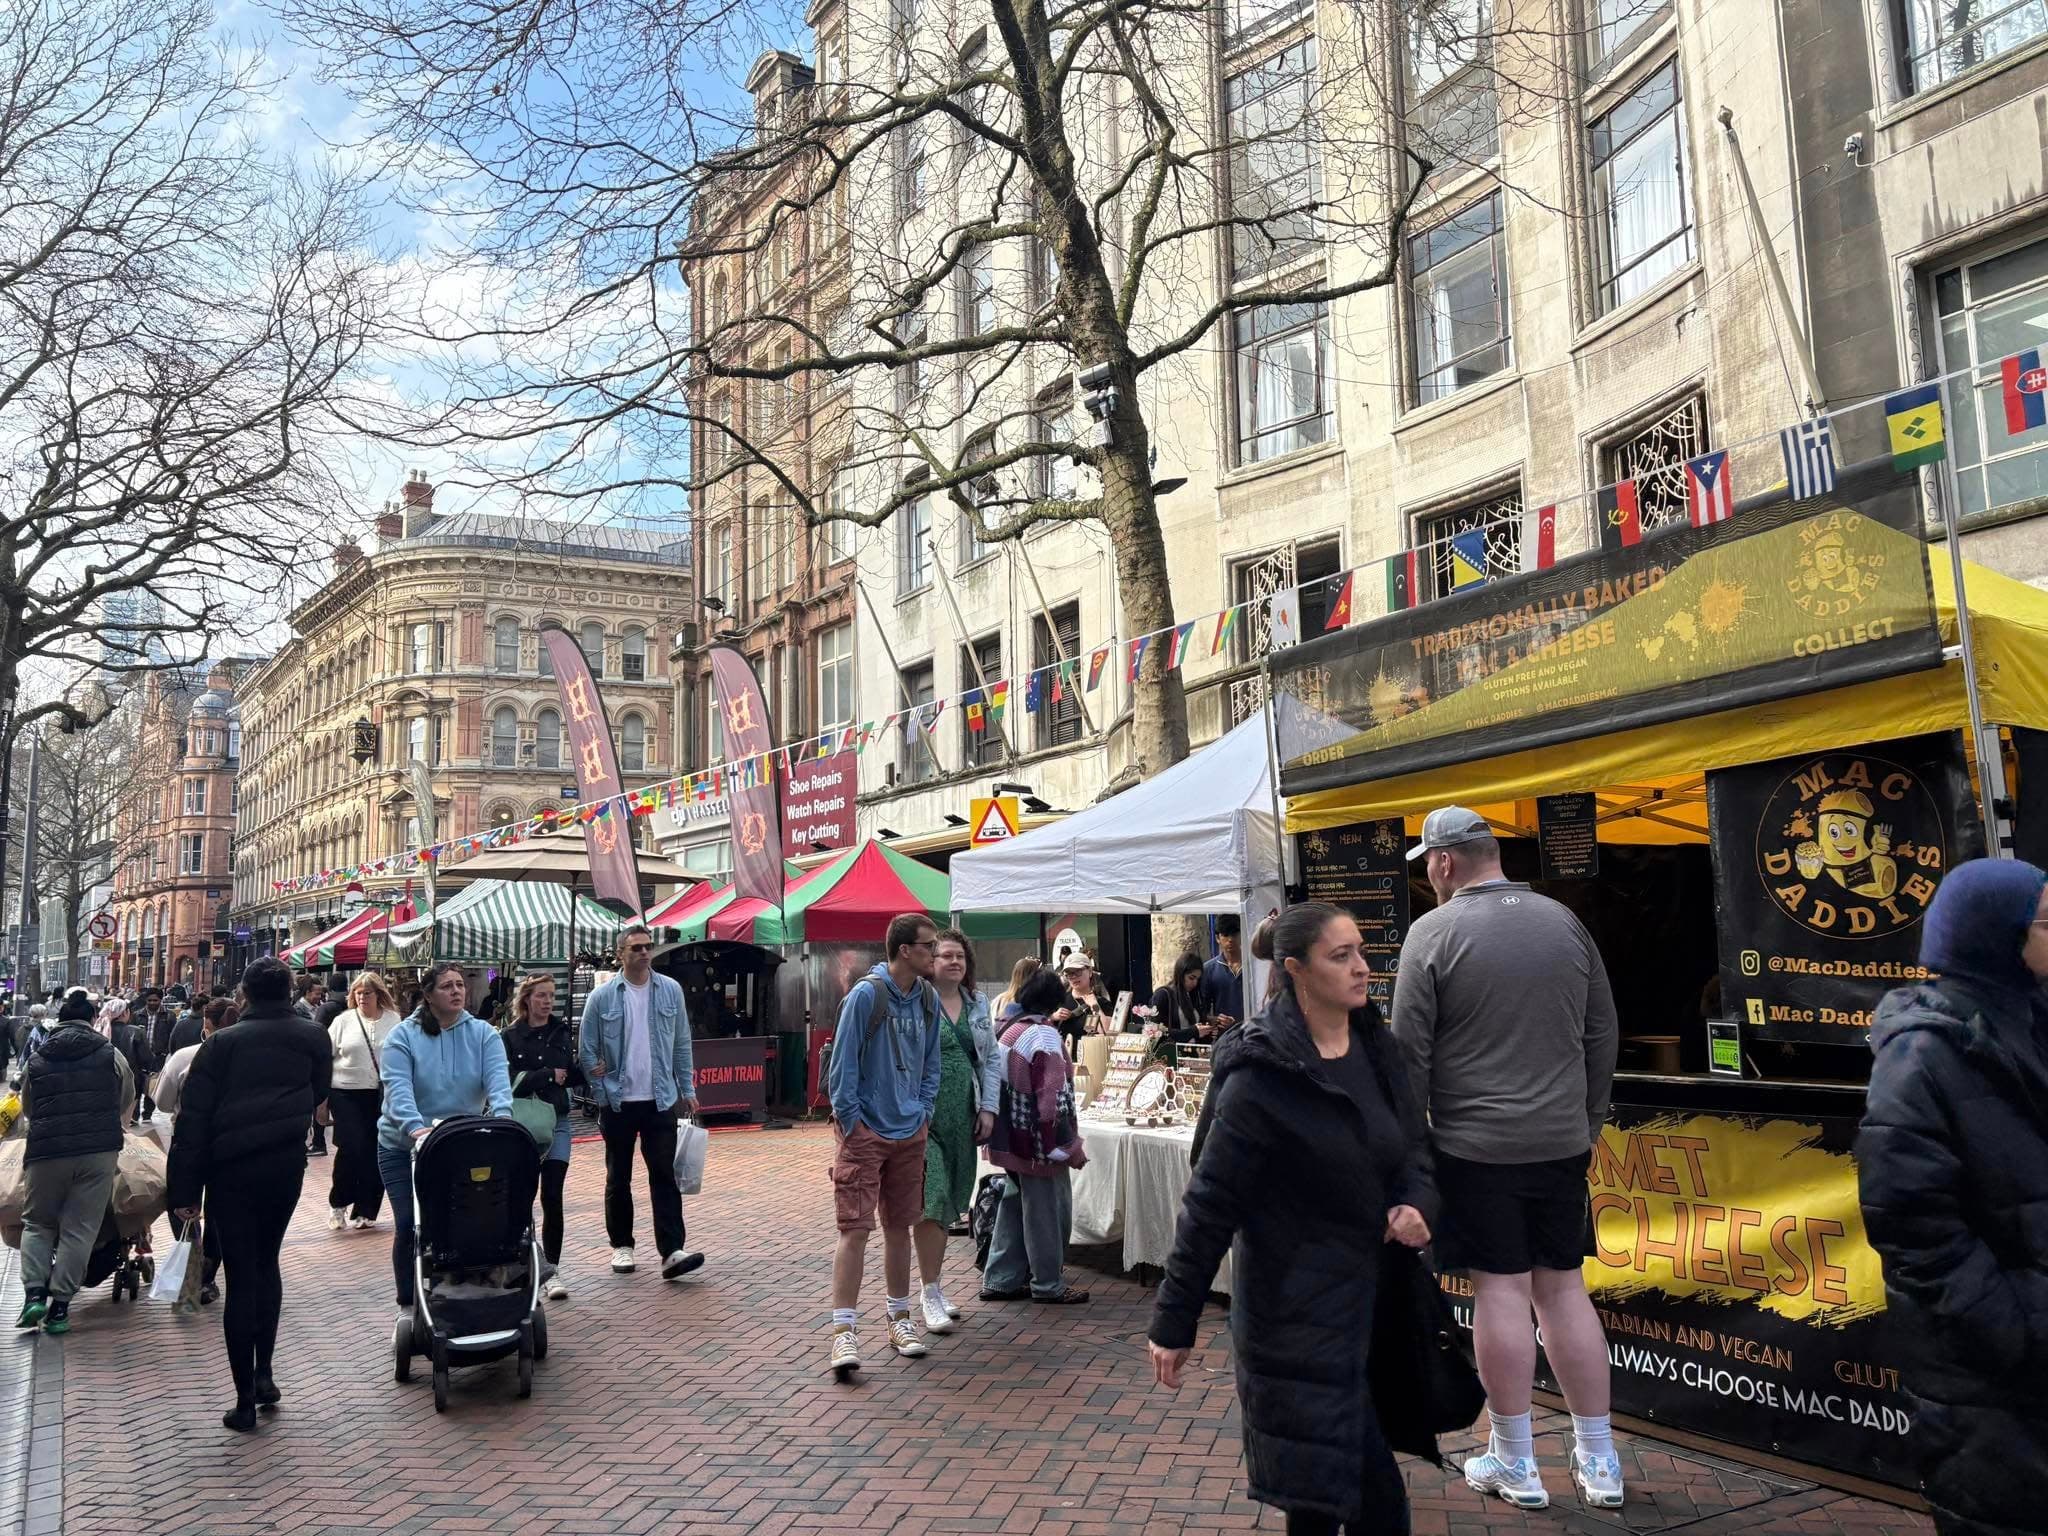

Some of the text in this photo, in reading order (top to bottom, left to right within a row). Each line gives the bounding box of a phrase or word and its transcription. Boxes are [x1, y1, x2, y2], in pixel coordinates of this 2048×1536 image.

[1799, 514, 1862, 545] MAC
[1787, 553, 1885, 617] DADDIES
[1411, 566, 1667, 660] TRADITIONALLY BAKED
[1793, 616, 1895, 658] COLLECT
[1456, 620, 1617, 682] MAC & CHEESE
[1483, 657, 1588, 691] GLUTEN FREE AND VEGAN
[1493, 673, 1579, 701] OPTIONS AVAILABLE
[1303, 745, 1345, 767] ORDER
[789, 769, 842, 796] Shoe Repairs
[1792, 761, 1912, 801] MAC
[787, 795, 845, 821] Watch Repairs
[791, 821, 840, 845] Key Cutting
[1339, 833, 1363, 846] MENU
[1377, 877, 1393, 889] 10
[1764, 846, 1941, 933] DADDIES
[1382, 904, 1398, 918] 12
[1384, 929, 1399, 942] 10
[1385, 958, 1400, 972] 10
[1768, 956, 1942, 979] @MacDaddies
[1769, 1005, 1815, 1022] Mac
[700, 1066, 732, 1085] STEAM
[735, 1064, 763, 1082] TRAIN
[1590, 1192, 1849, 1307] CHEESE
[1675, 1326, 1716, 1352] AND
[1720, 1334, 1794, 1373] VEGAN
[1834, 1360, 1900, 1393] GLUT
[1682, 1362, 1780, 1409] CHOOSE
[1783, 1385, 1844, 1422] MAC
[1849, 1398, 1911, 1436] DADD
